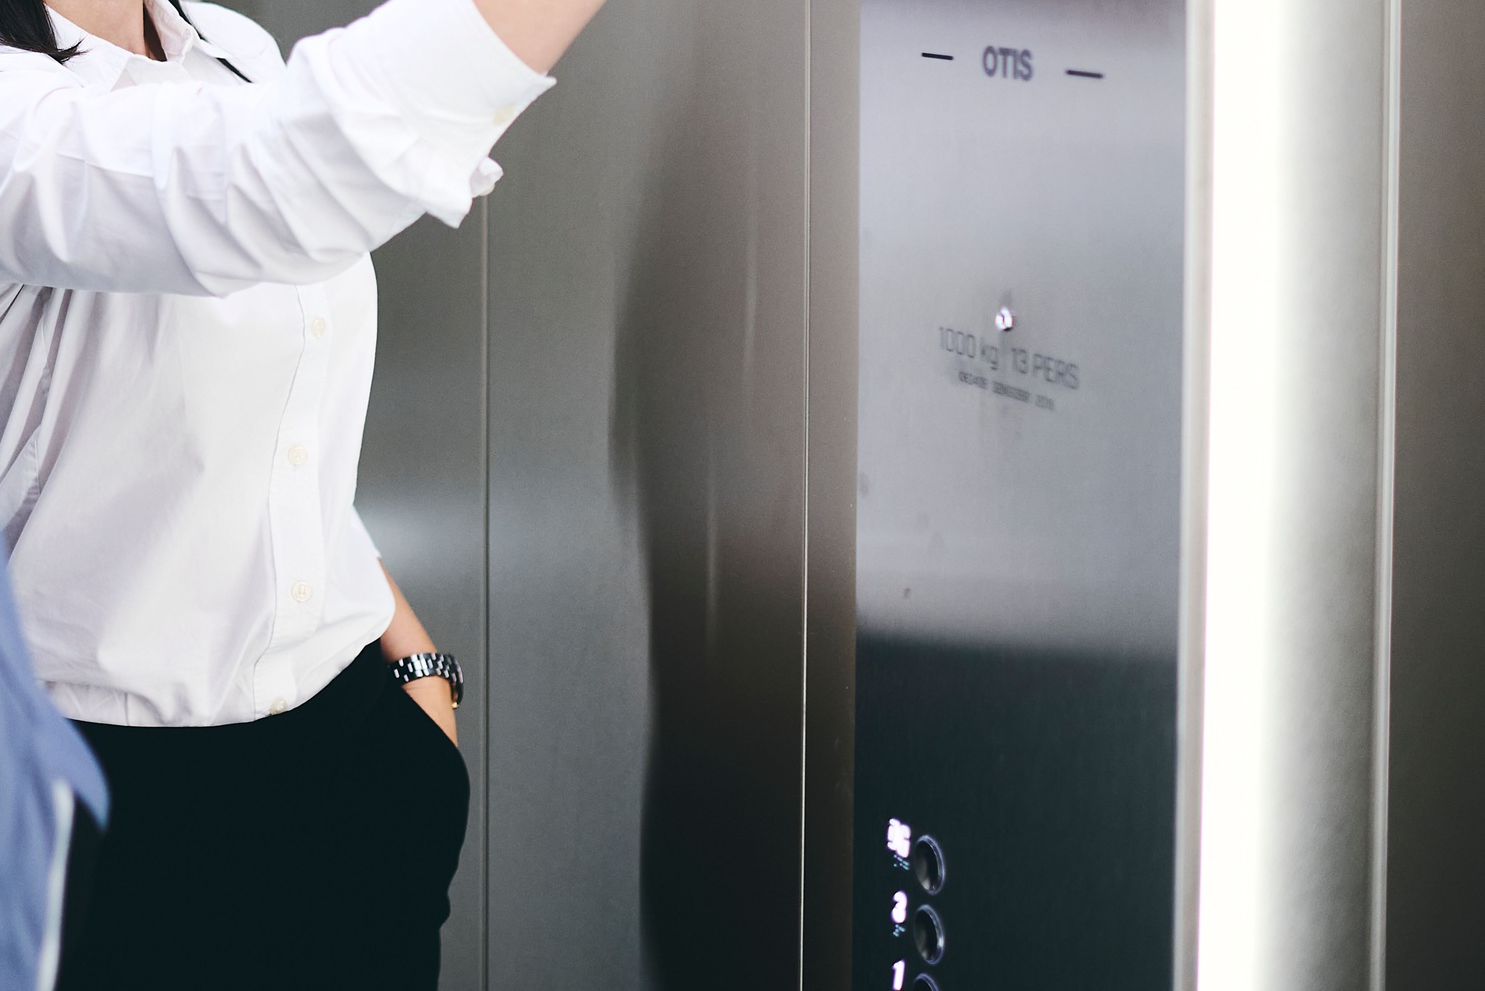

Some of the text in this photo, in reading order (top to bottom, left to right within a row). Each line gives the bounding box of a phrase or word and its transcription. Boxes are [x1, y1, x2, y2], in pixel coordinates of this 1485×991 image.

[982, 45, 1034, 82] OTIS
[939, 326, 1080, 390] 1000 kg 13 PERS
[892, 959, 906, 990] 1
